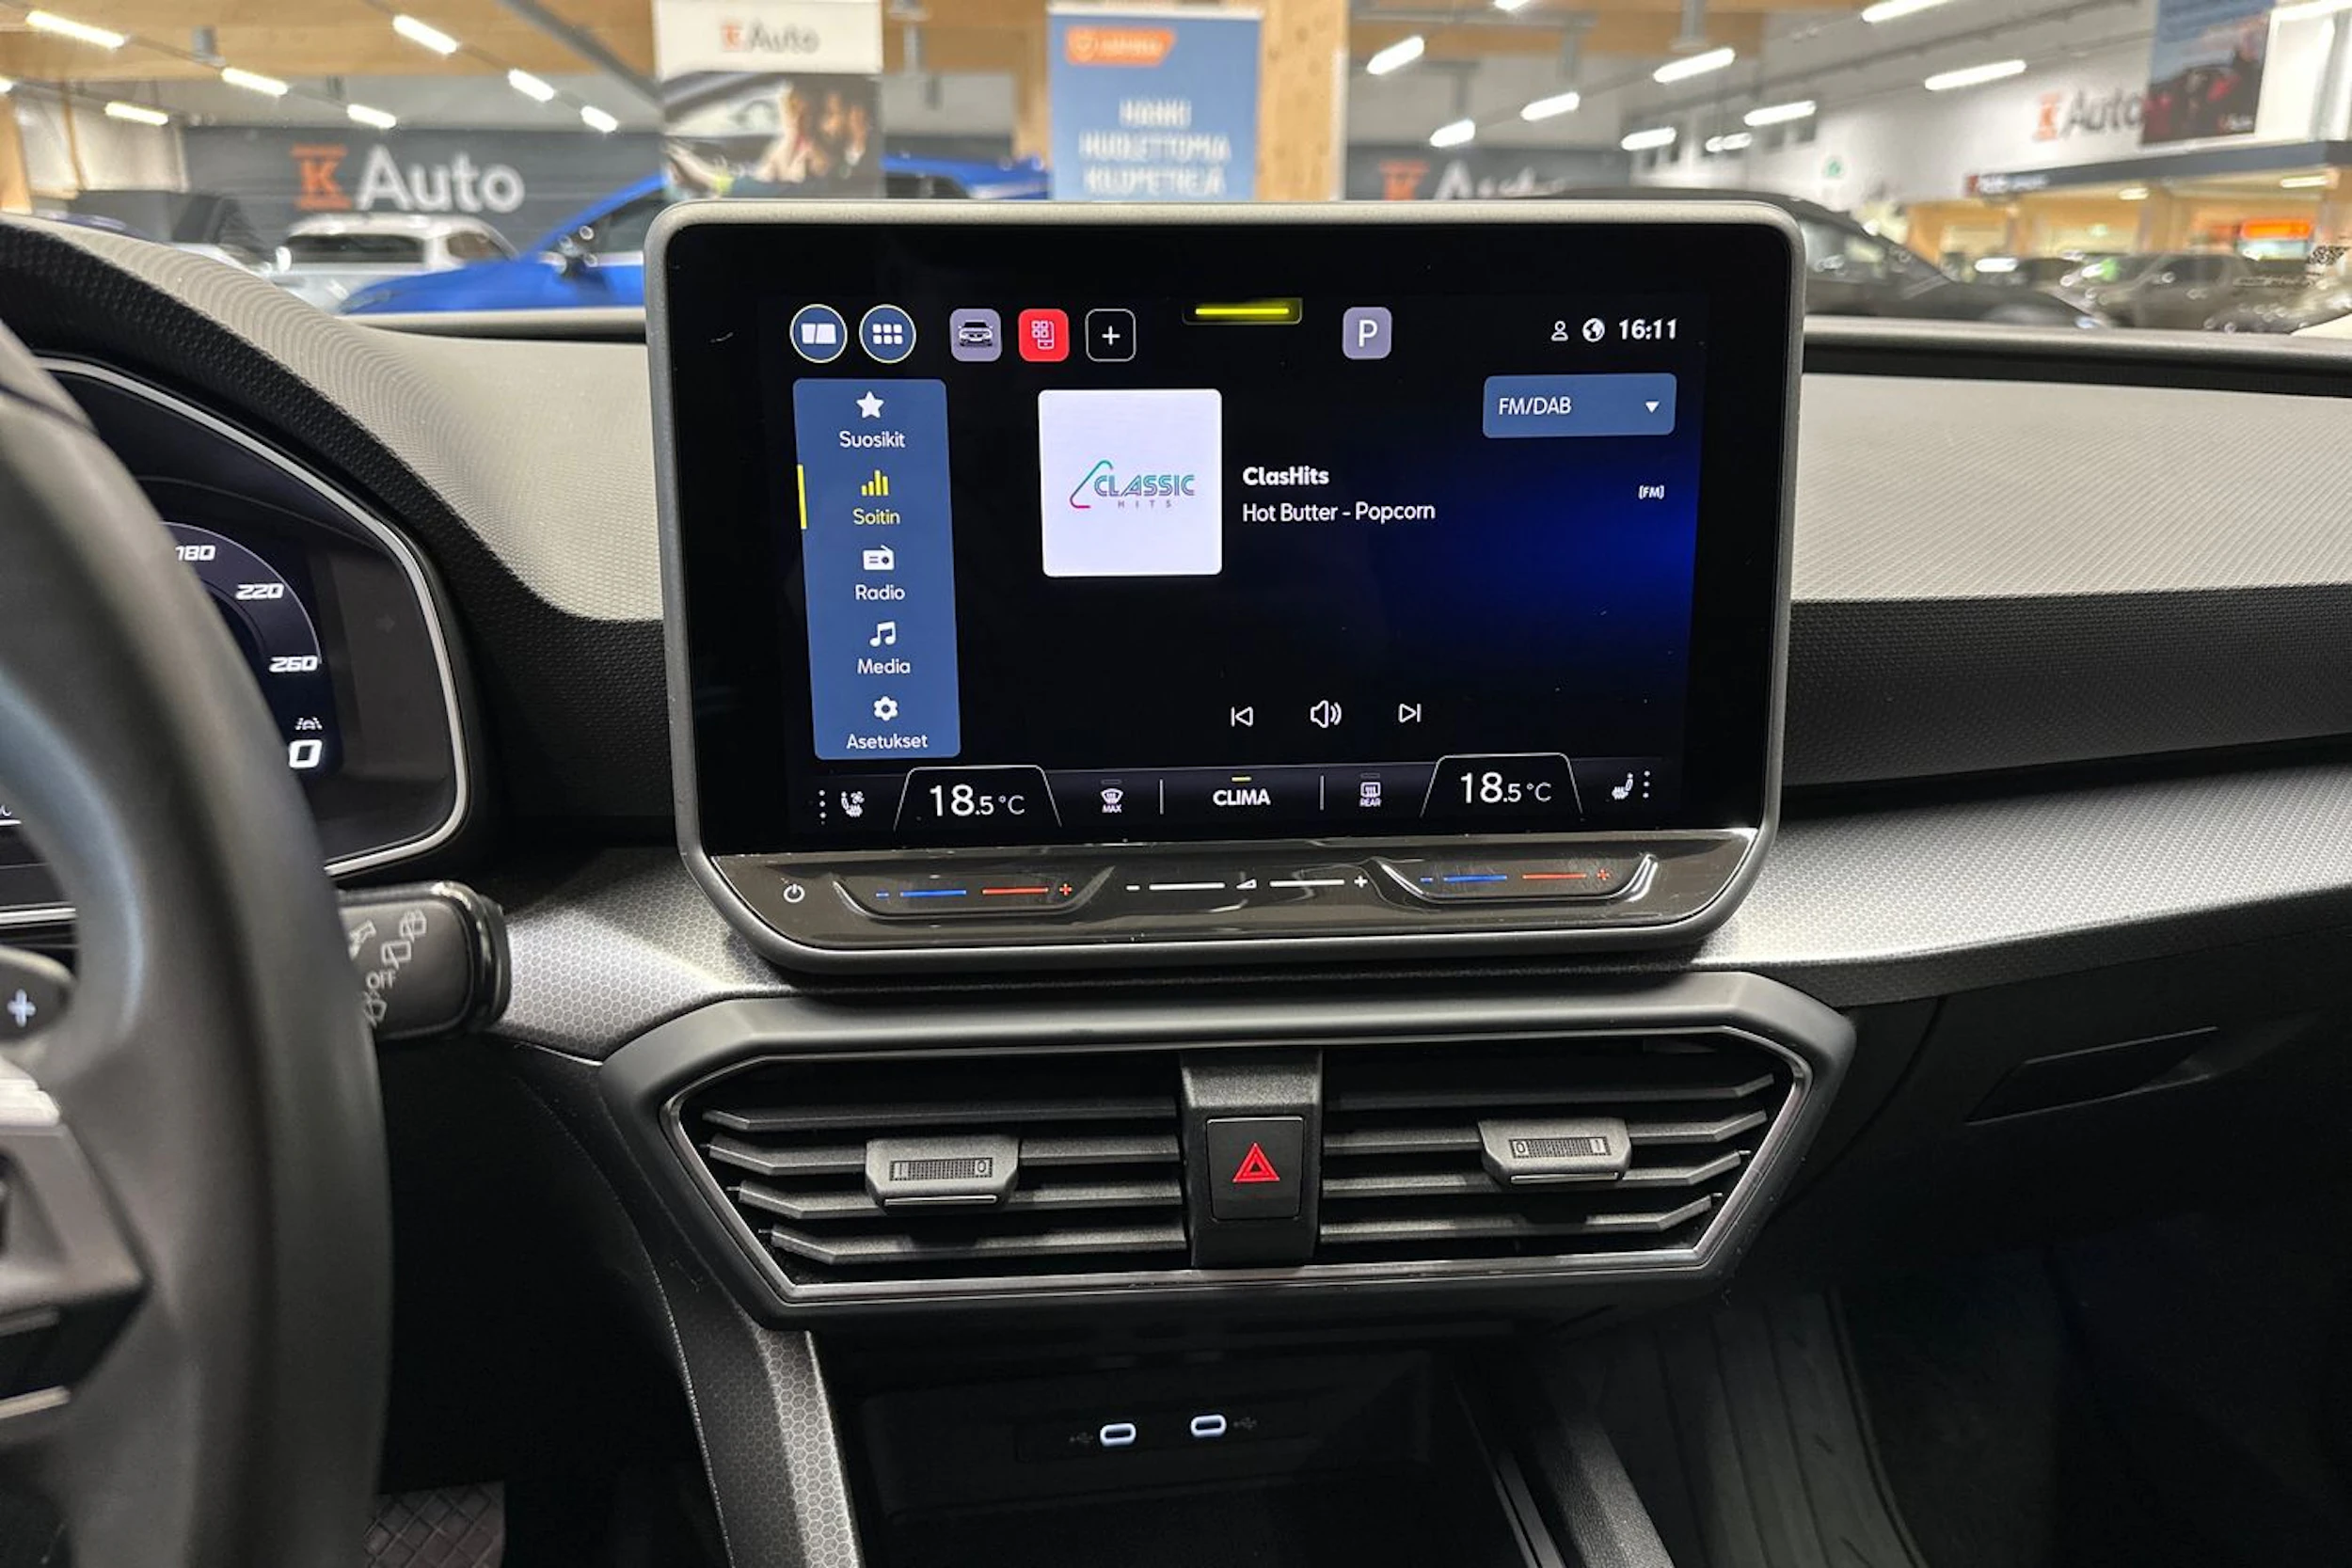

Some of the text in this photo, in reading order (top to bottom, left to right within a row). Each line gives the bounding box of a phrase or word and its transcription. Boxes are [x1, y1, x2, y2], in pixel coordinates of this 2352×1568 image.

[357, 144, 526, 213] Auto
[1618, 318, 1678, 341] 16:11
[1498, 396, 1572, 417] FM/DAB
[839, 430, 906, 450] Suosikit
[1093, 474, 1196, 497] CLASSIC
[1243, 466, 1329, 487] ClasHits
[852, 508, 900, 527] Soitin
[1242, 503, 1276, 523] Hot
[1280, 502, 1338, 523] Butter
[1355, 501, 1436, 525] Popcorn
[176, 545, 215, 561] 180
[236, 583, 284, 600] 220
[854, 584, 906, 602] Radio
[269, 656, 318, 673] 260
[857, 657, 912, 676] Media
[846, 732, 929, 751] Asetukset
[1213, 788, 1271, 806] CLIMA
[1359, 797, 1381, 808] REAR
[1102, 804, 1122, 814] MAX
[365, 970, 396, 990] OFF
